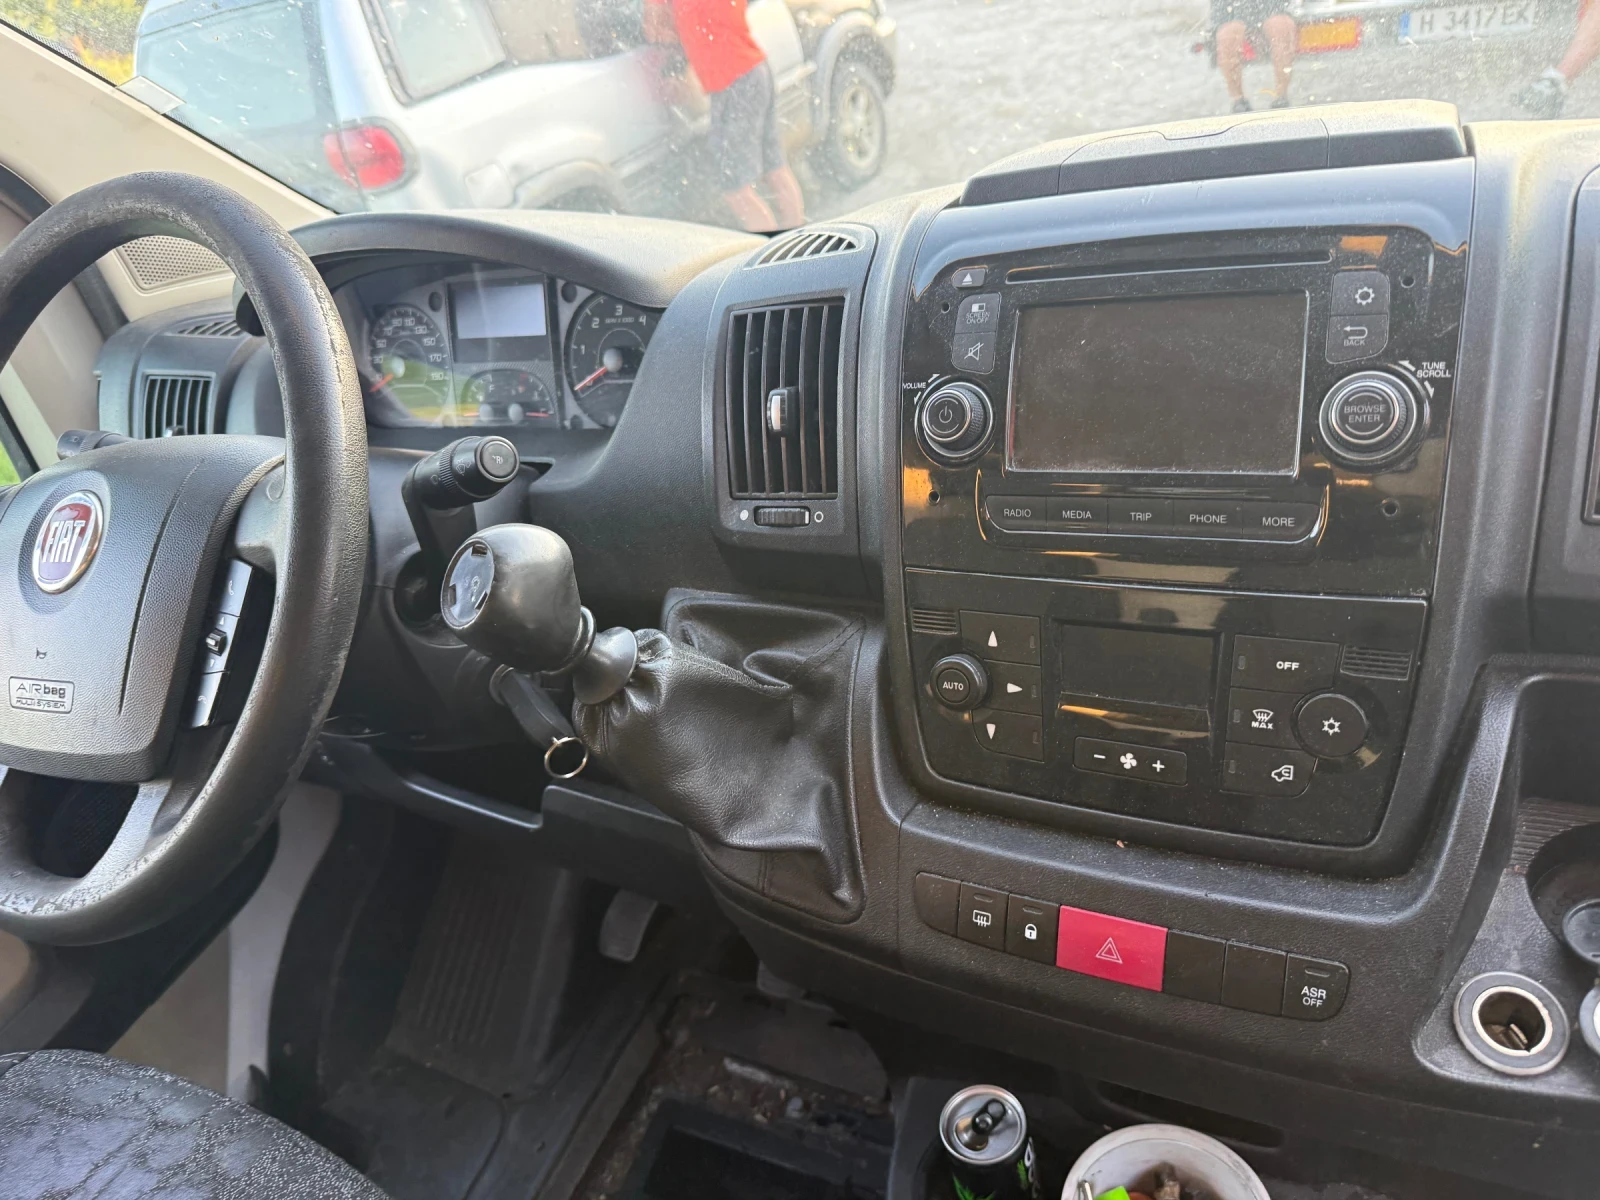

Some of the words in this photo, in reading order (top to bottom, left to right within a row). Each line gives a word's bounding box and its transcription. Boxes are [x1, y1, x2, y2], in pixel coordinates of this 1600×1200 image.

[615, 304, 623, 316] 3
[965, 311, 990, 319] SCREEN
[591, 317, 600, 328] 2
[639, 315, 647, 326] 4
[1343, 339, 1365, 347] BACK
[580, 344, 586, 355] 1
[429, 353, 442, 362] 170
[1422, 361, 1446, 370] TUNE
[1416, 369, 1452, 378] SCROLL
[1344, 404, 1387, 414] BROWSE
[1348, 414, 1381, 423] ENTER
[1003, 508, 1032, 518] RADIO
[1062, 510, 1092, 519] MEDIA
[1130, 511, 1152, 522] TRIP
[1189, 513, 1228, 524] PHONE
[1262, 516, 1296, 527] MORE
[42, 519, 86, 563] FIAT
[1275, 660, 1300, 671] OFF
[942, 681, 964, 691] AUTO
[1251, 720, 1274, 730] MAX
[1301, 985, 1327, 1000] ASR
[1302, 996, 1324, 1008] OFF
